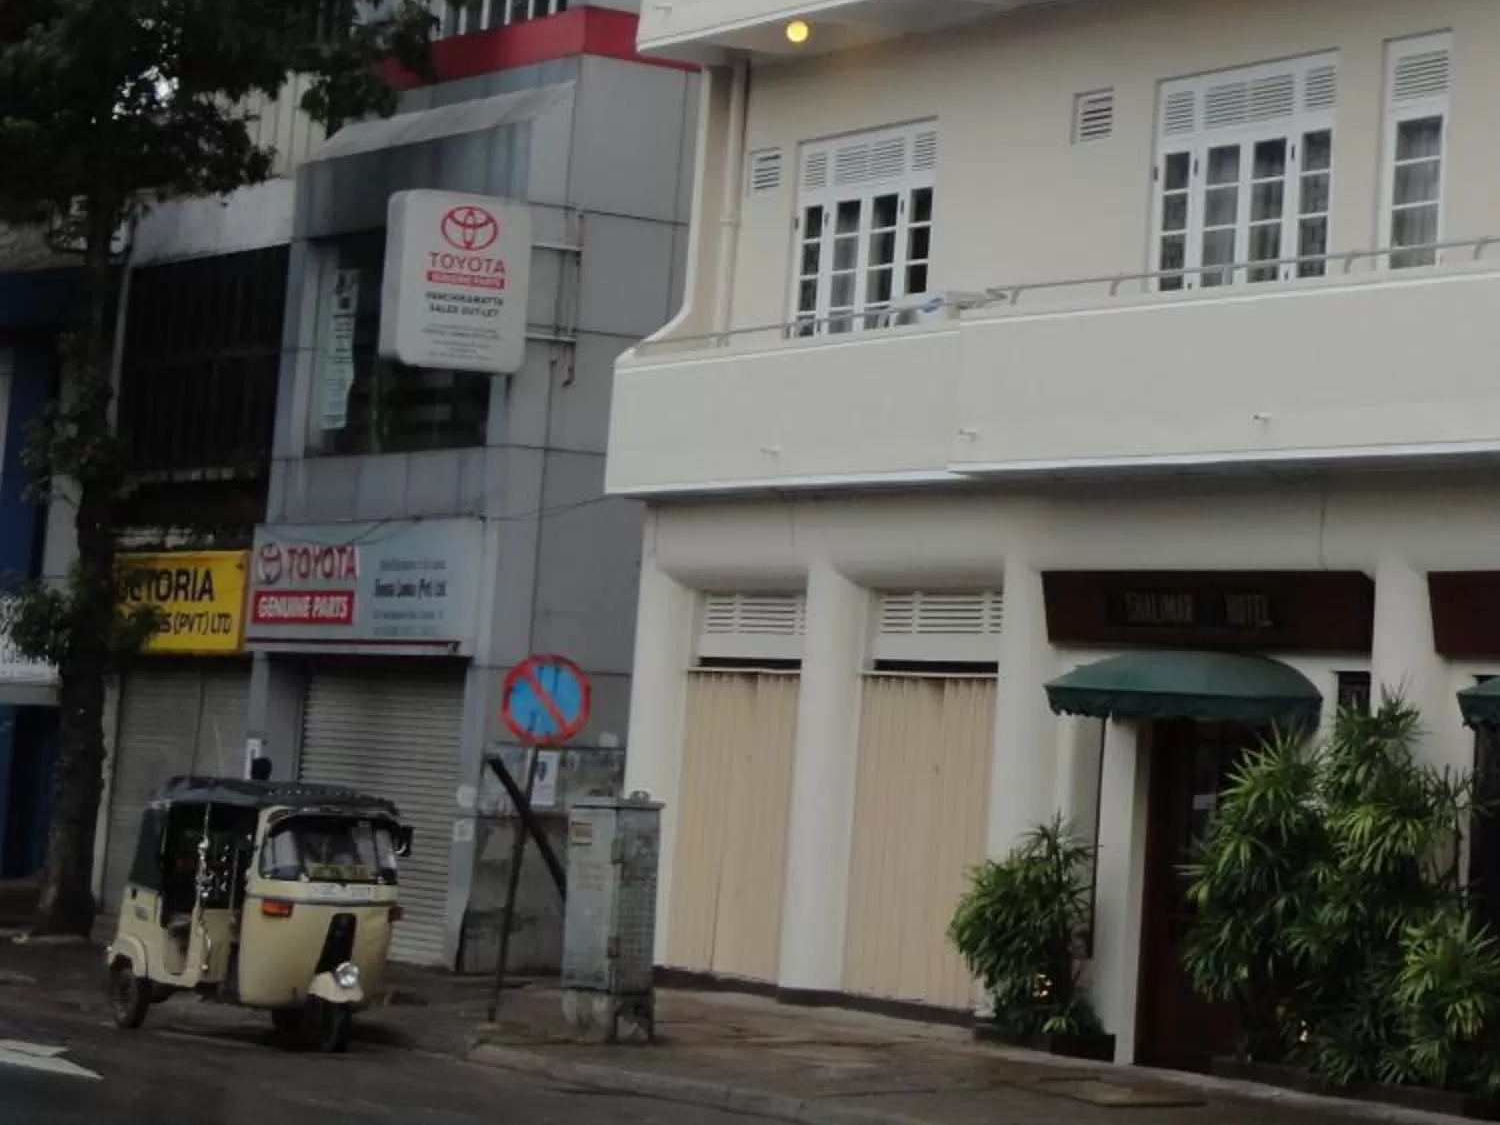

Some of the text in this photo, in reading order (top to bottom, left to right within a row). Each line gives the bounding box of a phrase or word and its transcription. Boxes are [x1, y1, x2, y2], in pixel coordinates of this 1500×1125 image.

[428, 251, 506, 274] TOYOTA
[287, 544, 358, 582] TOYOTA
[258, 595, 311, 619] GENUINE
[312, 595, 349, 619] PARTS
